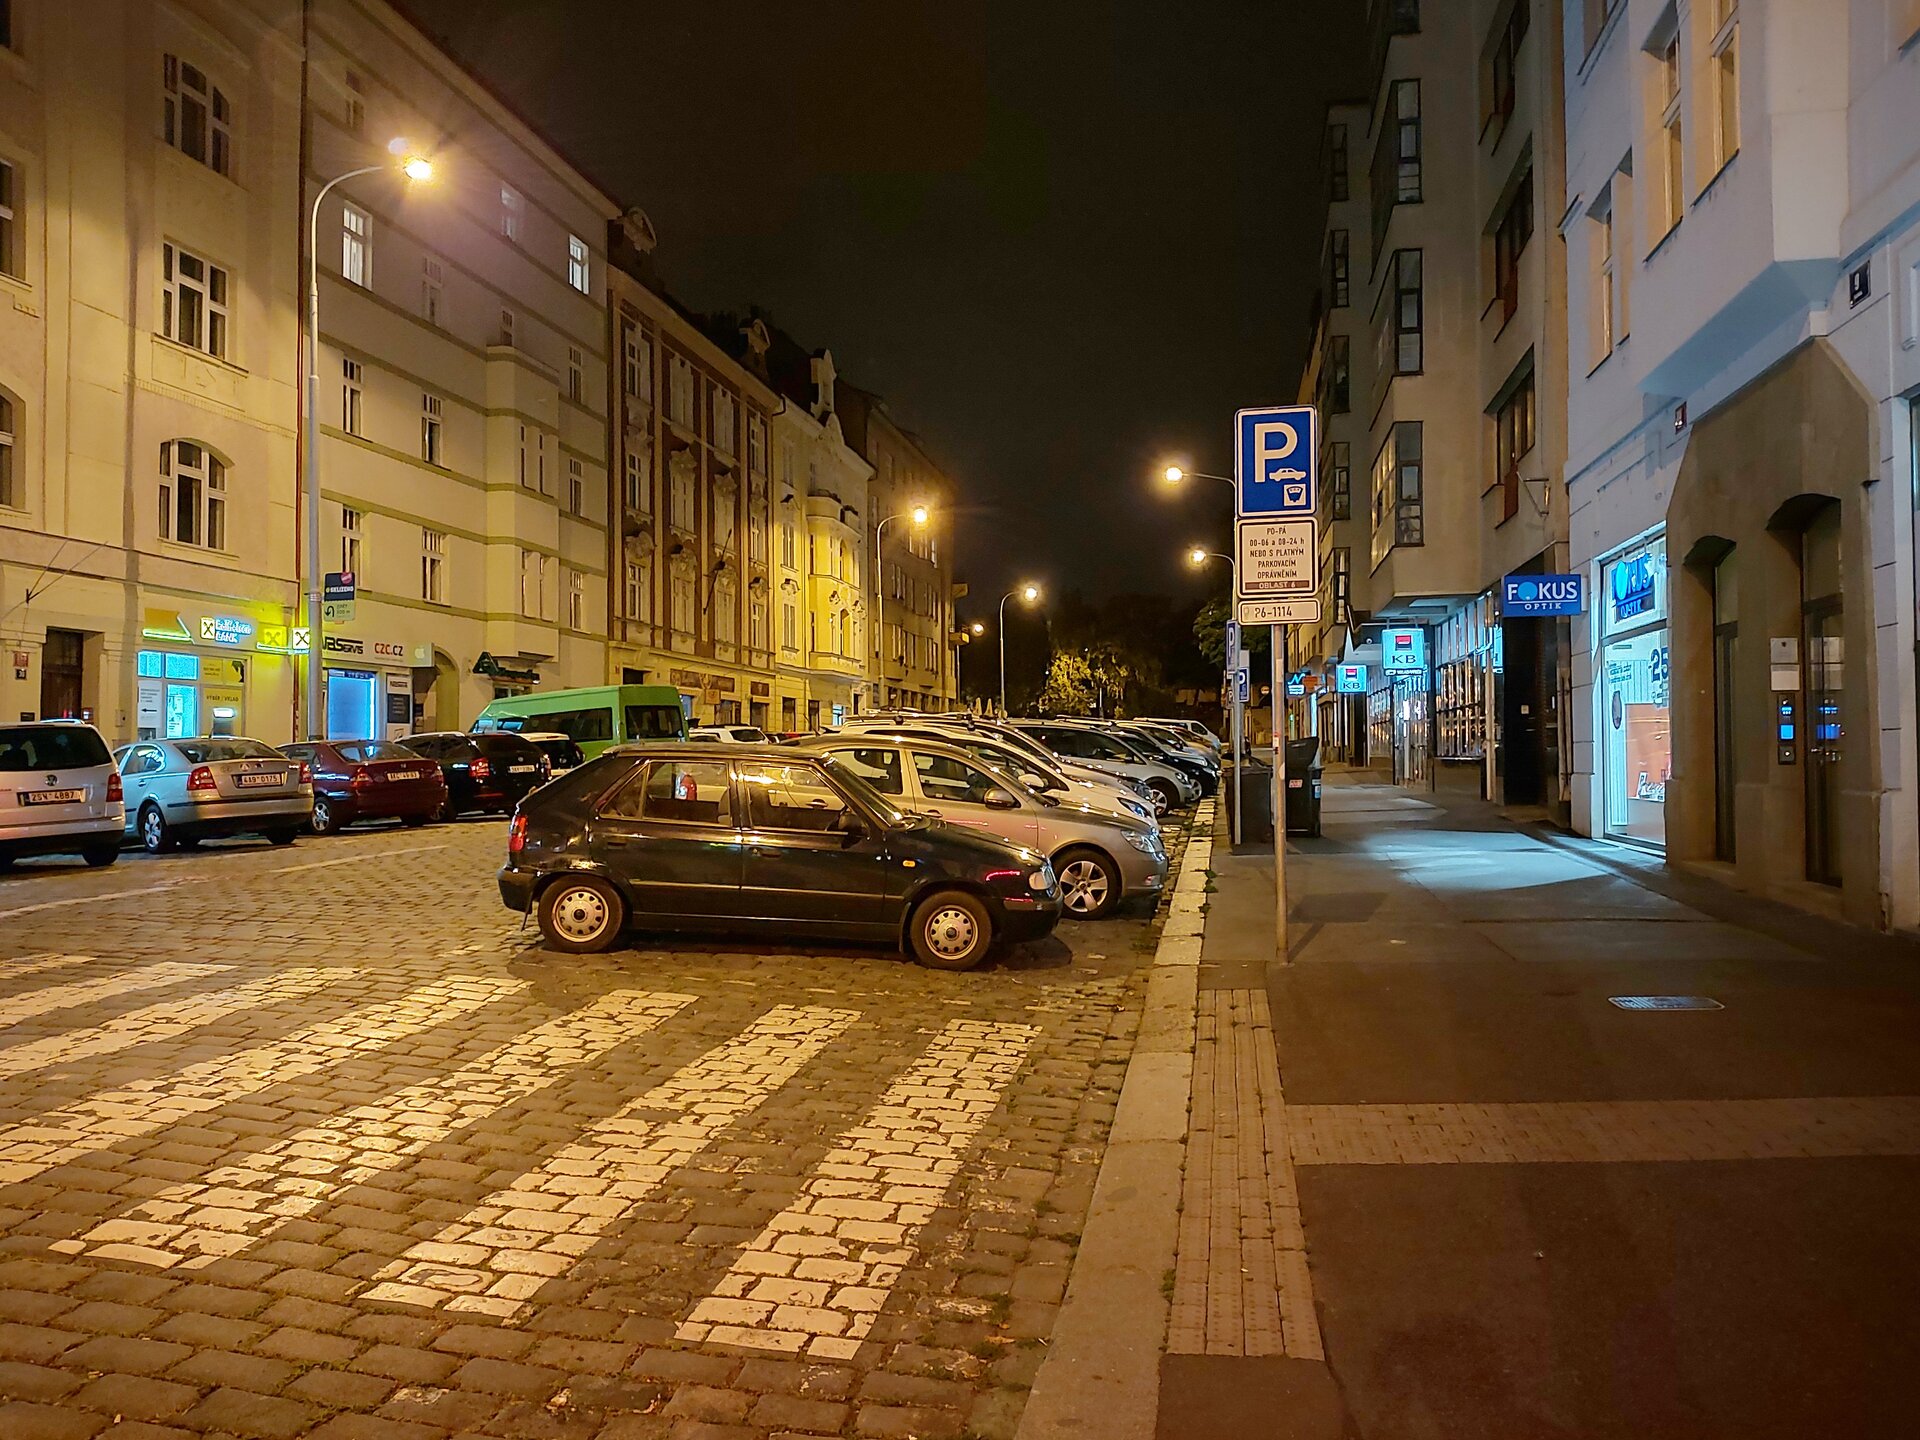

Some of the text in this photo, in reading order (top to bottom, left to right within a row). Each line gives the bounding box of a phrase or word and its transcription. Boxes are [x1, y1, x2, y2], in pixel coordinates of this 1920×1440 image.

[1255, 422, 1298, 483] P
[1266, 525, 1287, 535] PO-PÁ
[1300, 537, 1305, 545] h
[1249, 546, 1304, 558] NEBO S PLATNÝM
[1257, 558, 1297, 568] PARKOVACÍM
[1257, 569, 1297, 579] OPRÁVNĚNÍM
[1258, 581, 1288, 589] OBLAST
[1507, 581, 1578, 601] FOKUS
[1524, 602, 1562, 610] OPTIK
[374, 642, 403, 656] CZC.CZ
[1392, 654, 1417, 664] KB
